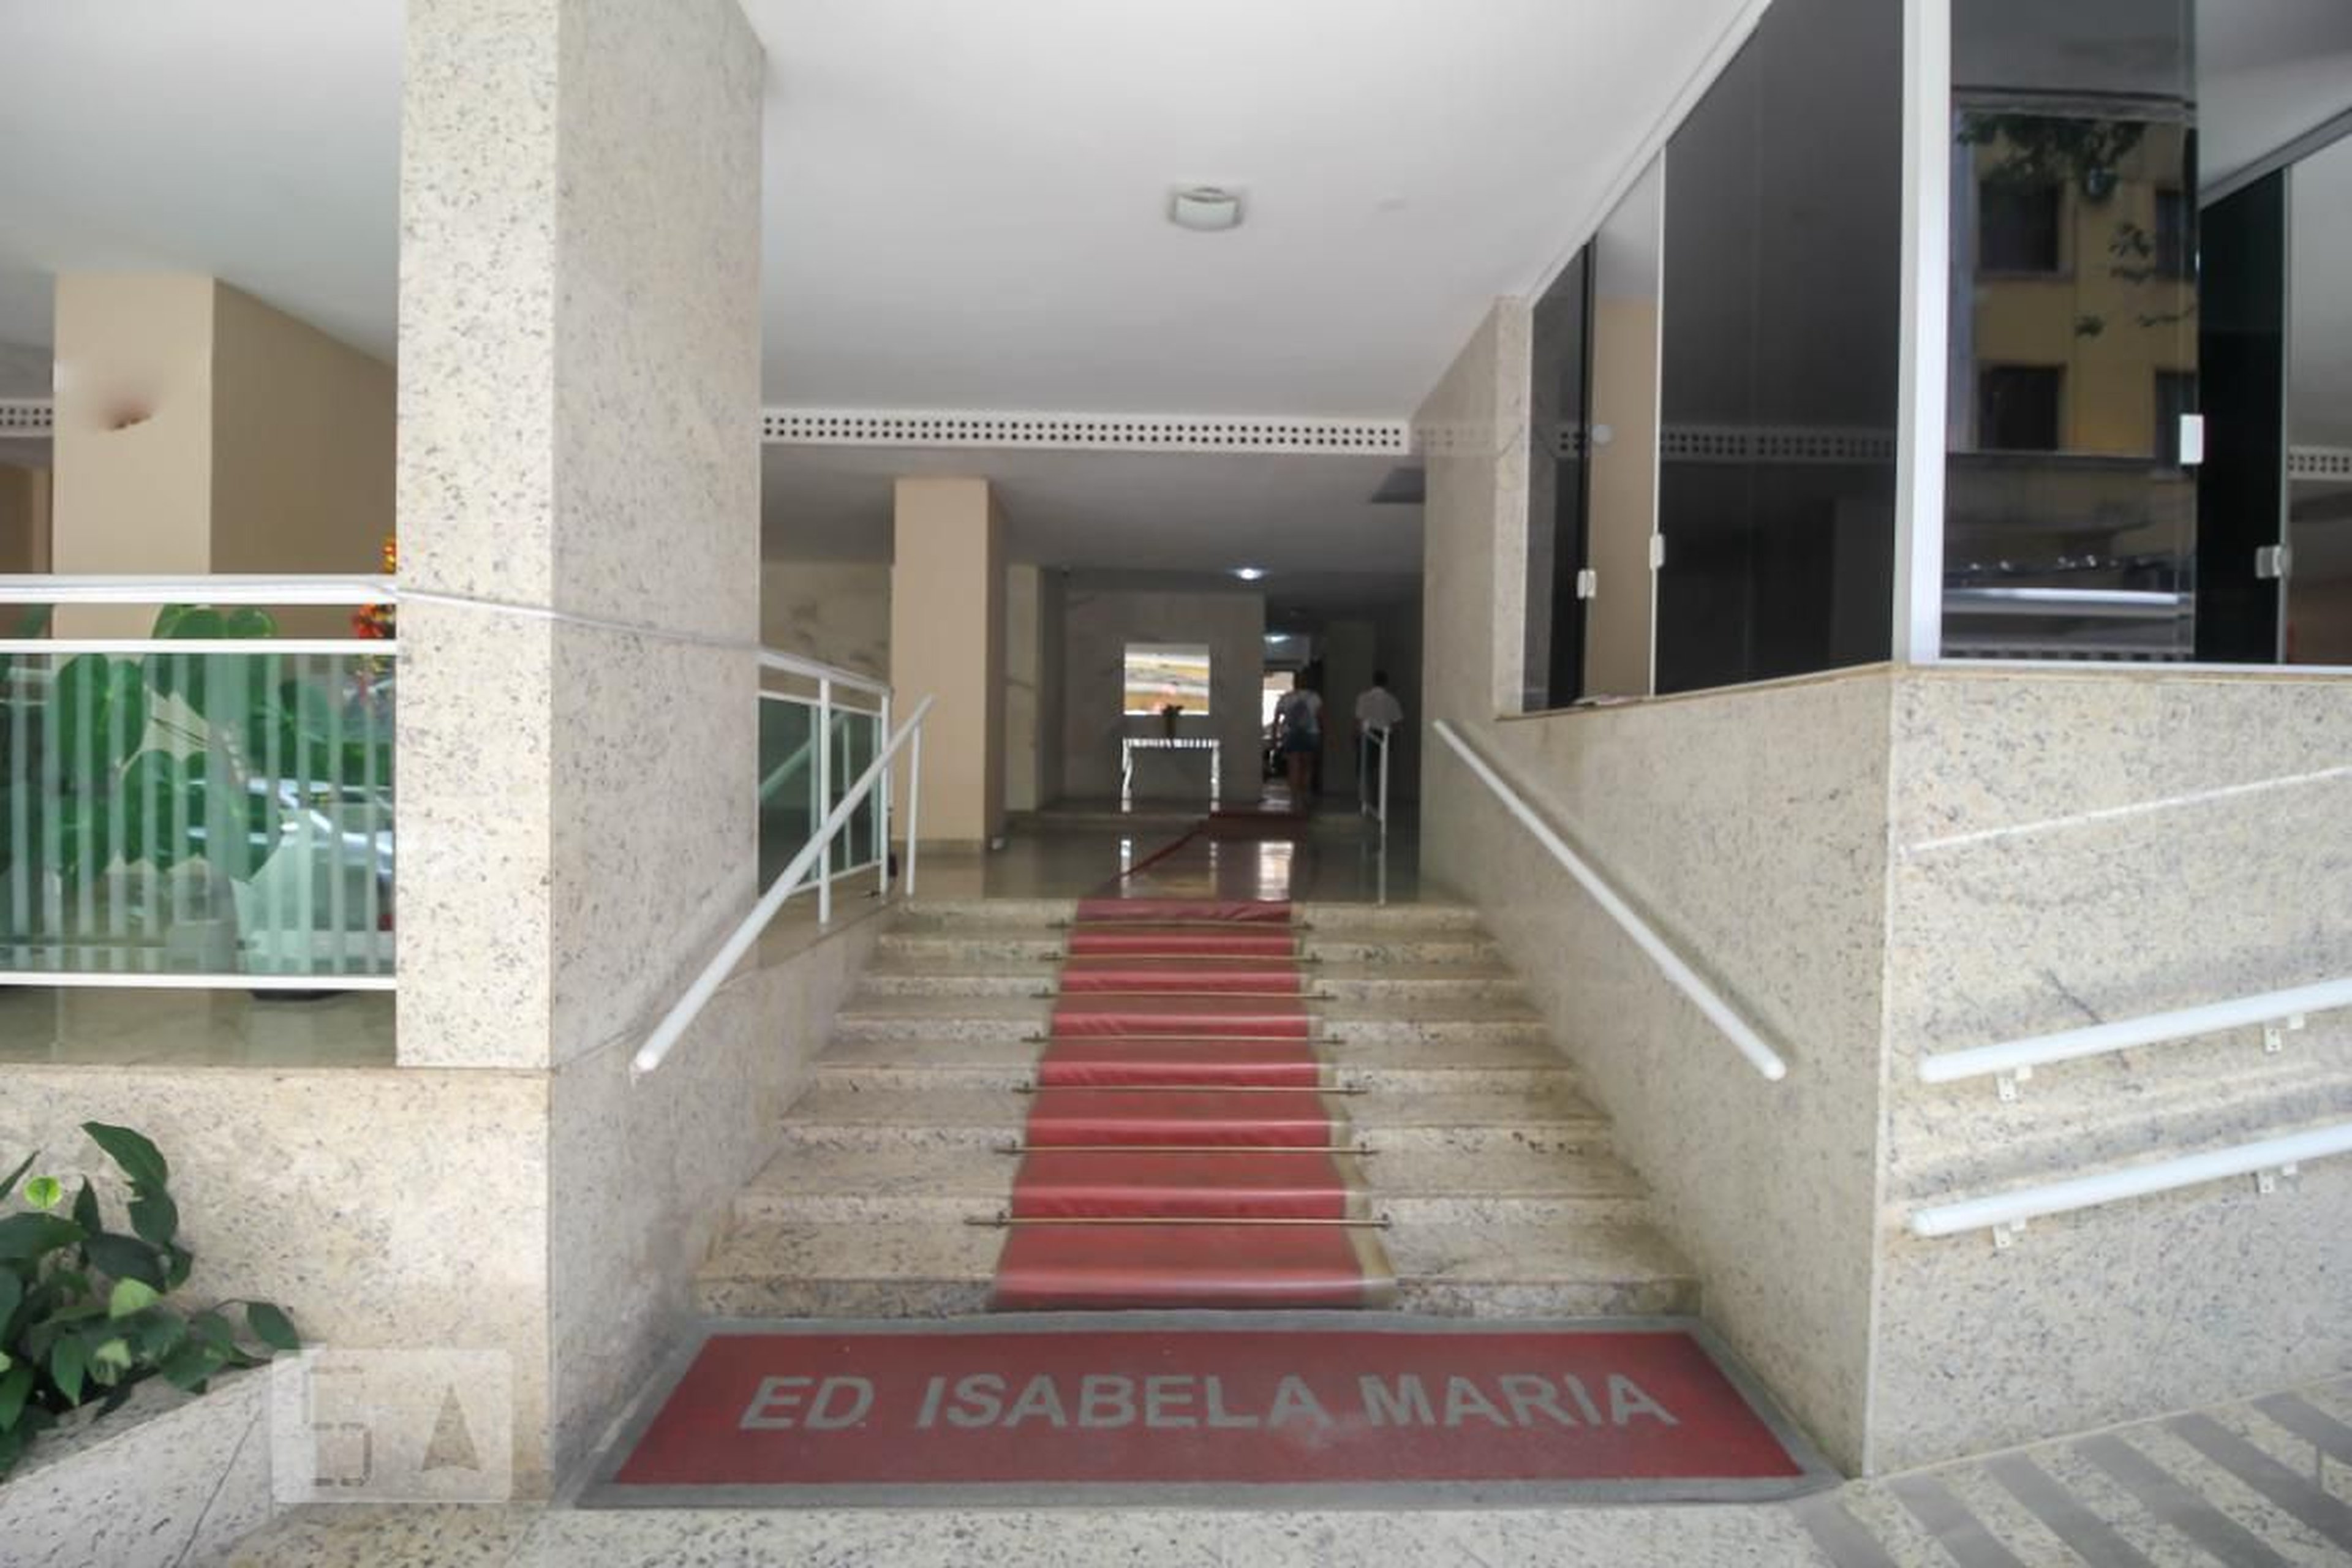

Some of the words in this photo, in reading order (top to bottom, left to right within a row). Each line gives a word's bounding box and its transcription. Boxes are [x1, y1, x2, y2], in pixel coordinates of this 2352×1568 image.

[740, 1376, 874, 1429] ED
[916, 1373, 1333, 1428] ISABELA
[1358, 1374, 1679, 1427] MARIA
